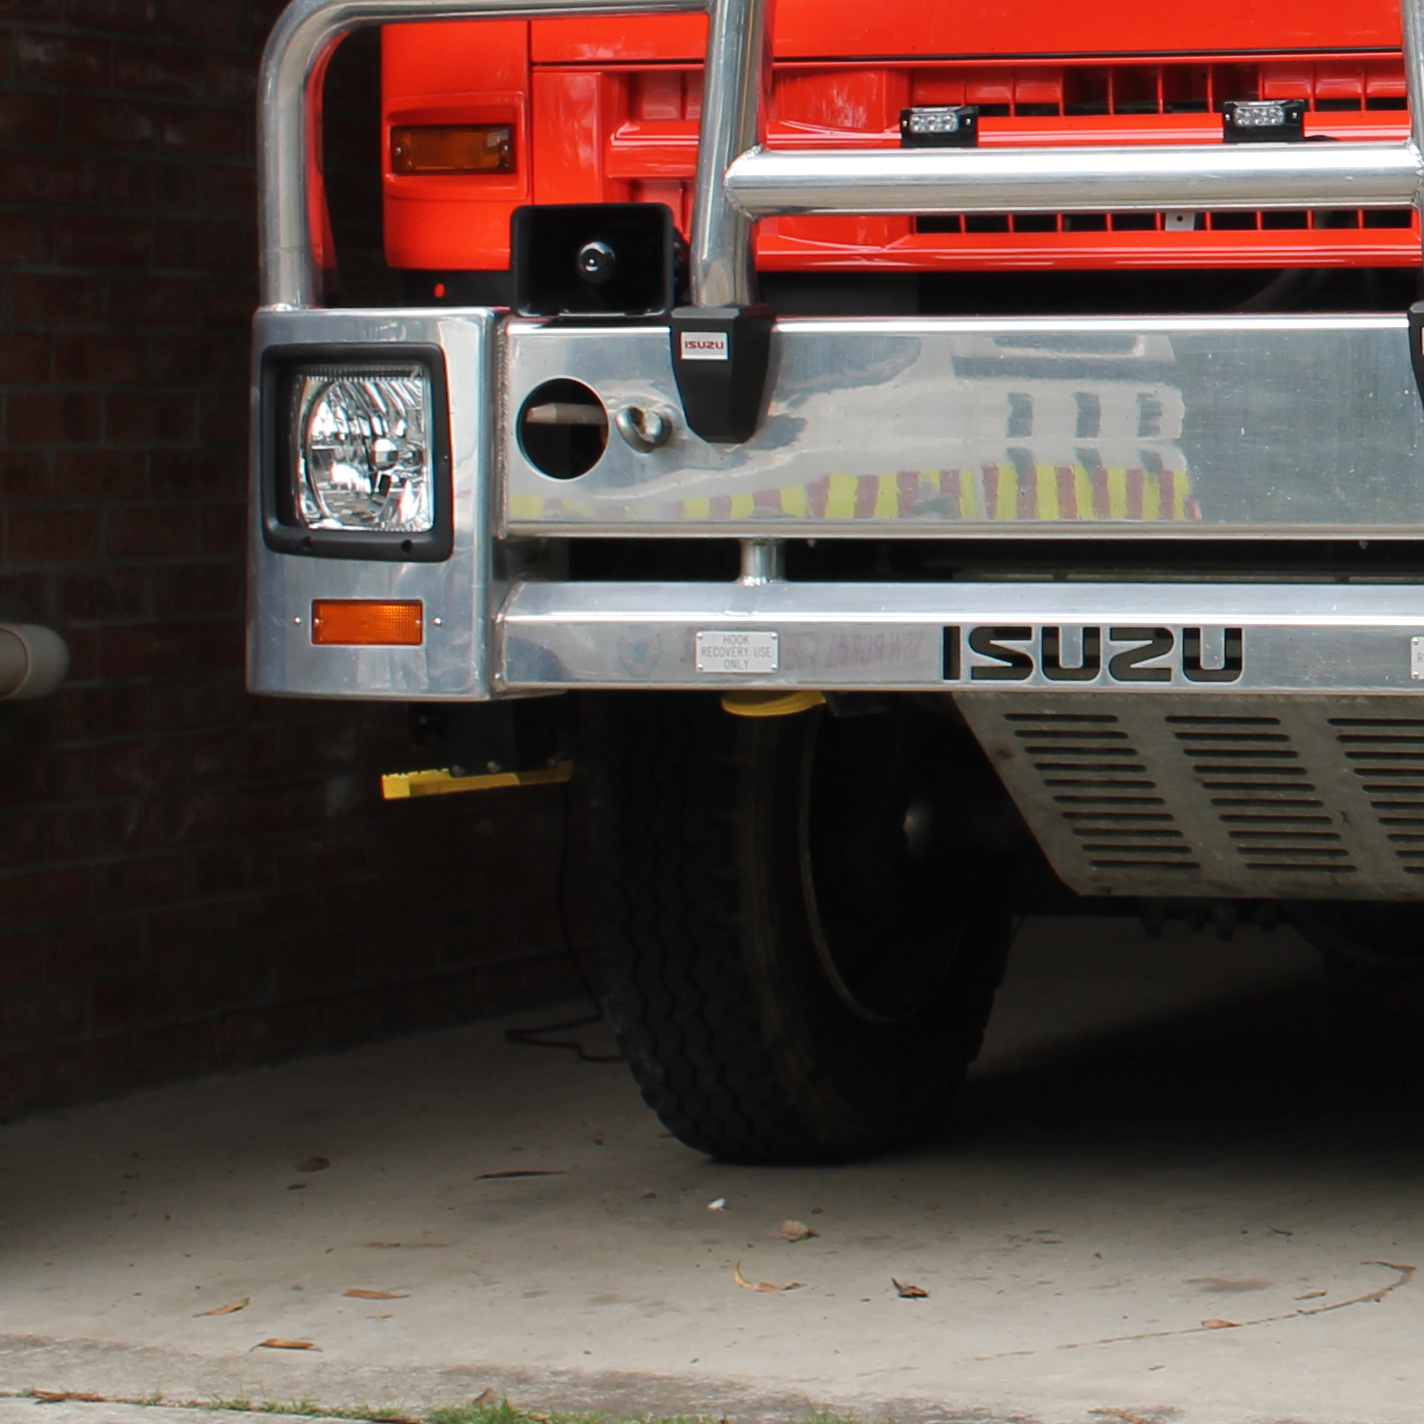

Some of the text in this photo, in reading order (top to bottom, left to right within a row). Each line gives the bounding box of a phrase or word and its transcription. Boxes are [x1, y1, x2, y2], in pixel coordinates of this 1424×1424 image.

[684, 341, 724, 349] ISUZU
[723, 634, 750, 645] HOOK
[701, 645, 772, 658] RECOVERY USE
[942, 625, 1244, 682] ISUZU
[723, 659, 750, 670] ONLY
